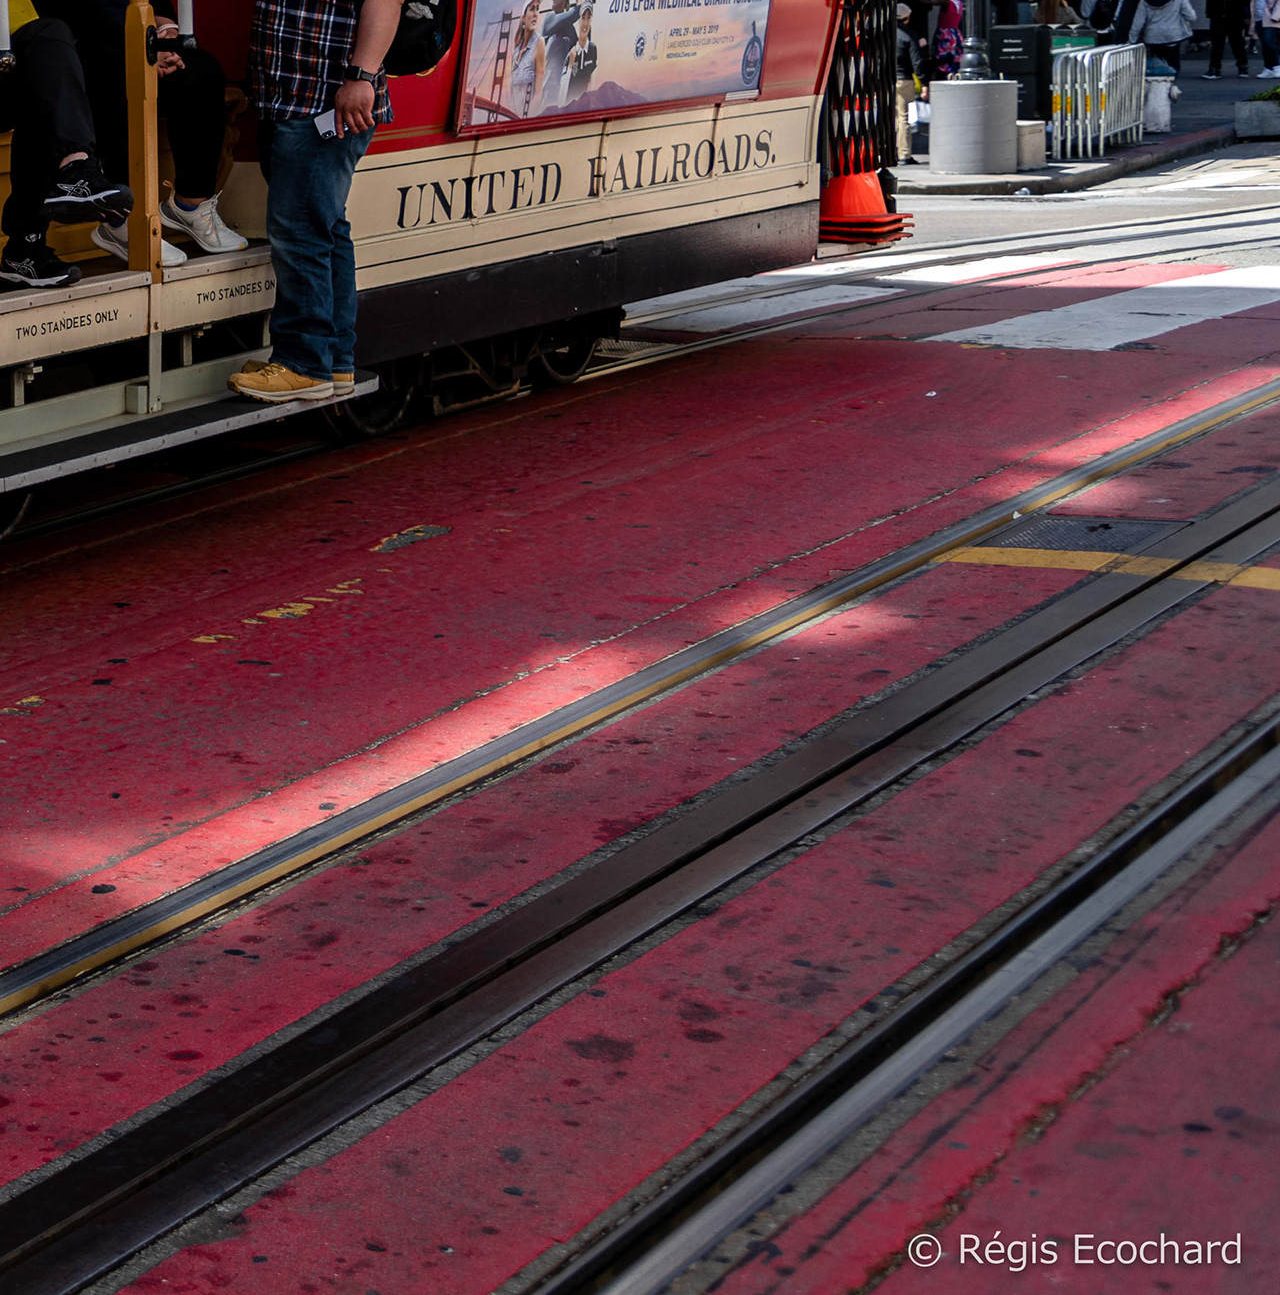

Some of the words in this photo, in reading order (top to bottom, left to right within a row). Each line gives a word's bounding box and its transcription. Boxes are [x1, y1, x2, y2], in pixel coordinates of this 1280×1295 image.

[669, 27, 682, 38] APRIL
[683, 27, 689, 36] 29
[692, 26, 702, 35] MAY
[708, 25, 719, 34] 2019
[397, 161, 562, 229] UNITED
[587, 129, 777, 199] RAILROADS.
[197, 291, 216, 305] TWO
[218, 283, 262, 301] STANDEES
[16, 324, 38, 340] TWO
[40, 313, 92, 335] STANDEES
[95, 309, 119, 325] ONLY
